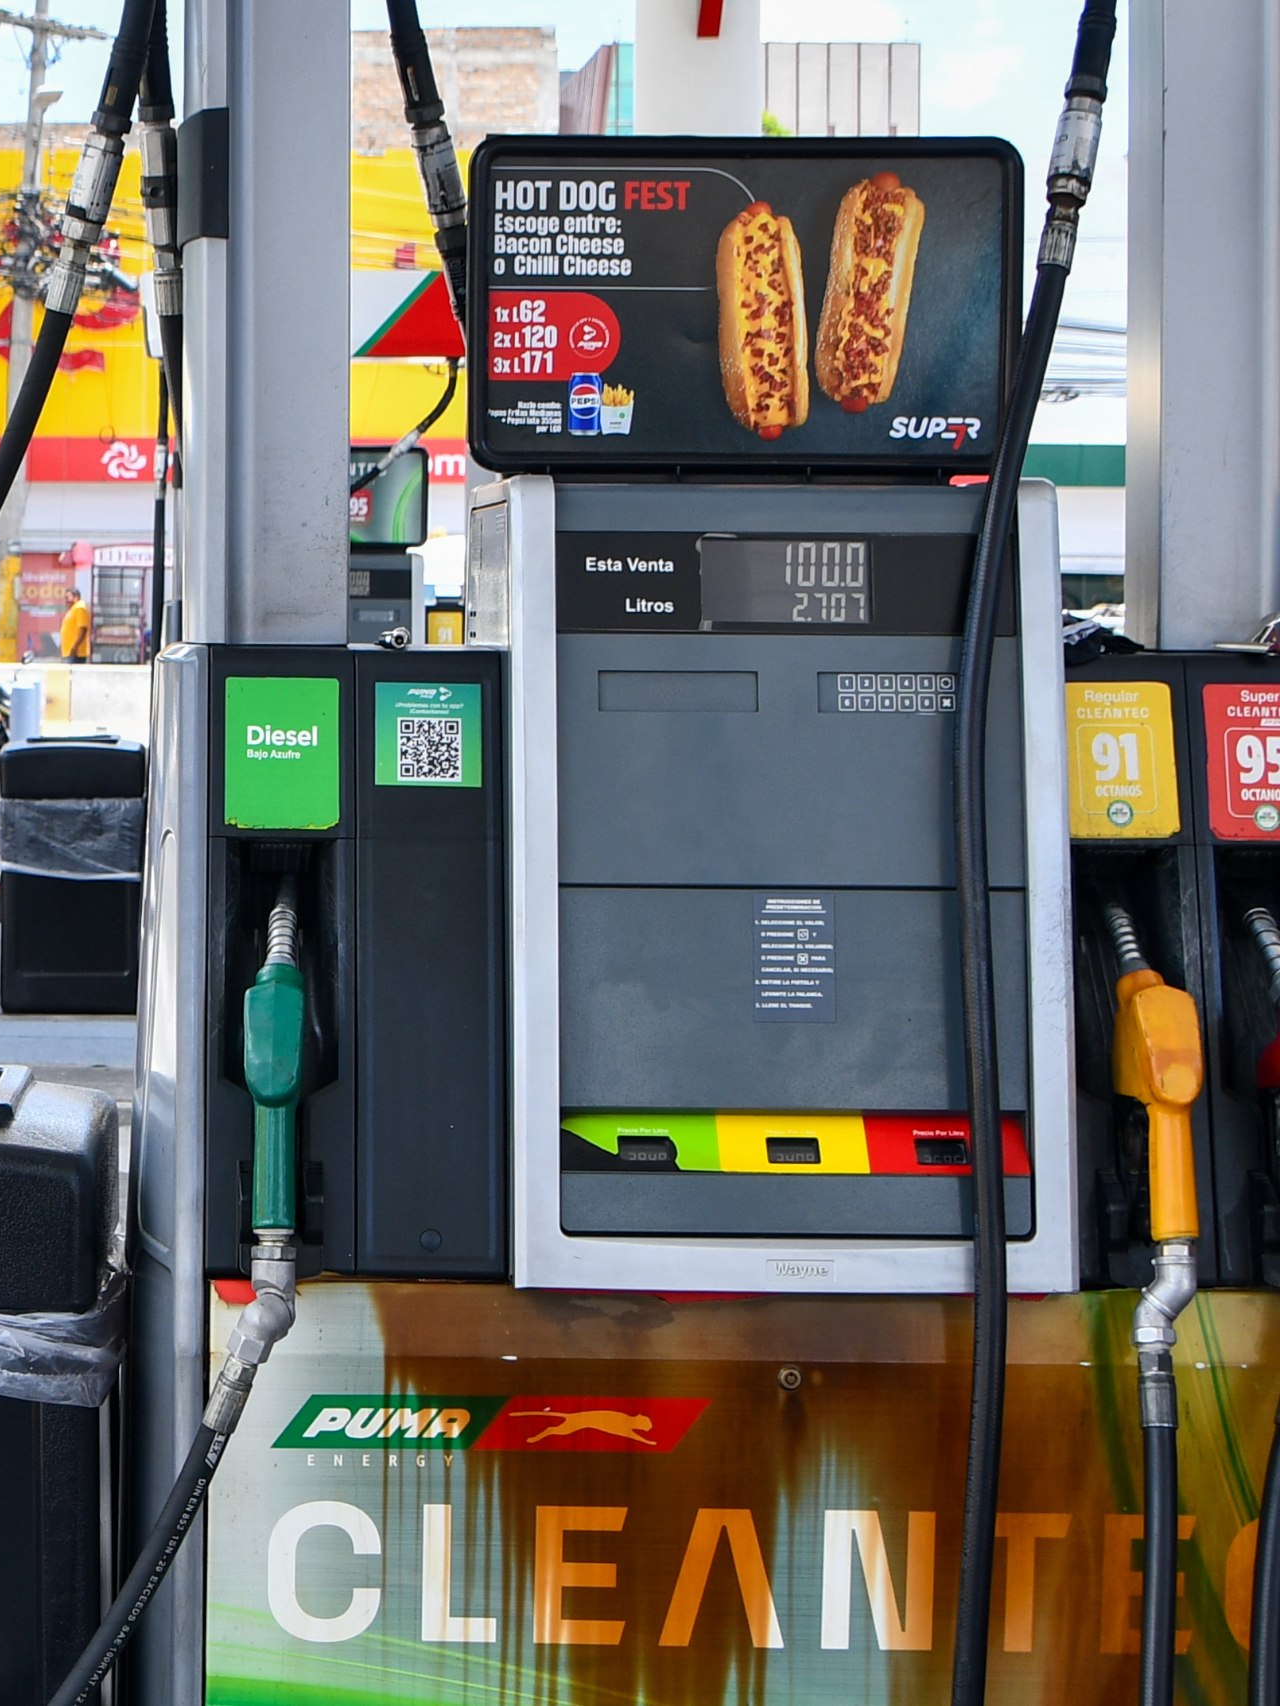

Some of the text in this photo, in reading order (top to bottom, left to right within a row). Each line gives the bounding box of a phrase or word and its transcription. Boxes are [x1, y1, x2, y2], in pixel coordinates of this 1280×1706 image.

[495, 180, 691, 211] HOT DOG FEST
[494, 213, 622, 236] Escoge entre:
[494, 234, 625, 255] Bacon Cheese
[494, 255, 632, 276] o Chilli Cheese
[494, 306, 510, 323] 1x
[494, 332, 512, 348] 2x
[493, 357, 511, 374] 3x
[571, 397, 599, 405] PEPSI
[585, 557, 622, 572] Esta
[626, 557, 675, 572] Venta
[625, 593, 865, 622] Litros 2.707
[1084, 689, 1139, 708] Regular
[1240, 690, 1280, 704] Super
[1077, 707, 1150, 719] CLEANTEC
[1227, 705, 1280, 717] CLEANT
[246, 725, 318, 747] Diesel
[246, 749, 301, 760] Bajo Azufre
[1091, 732, 1140, 782] 91
[1095, 785, 1143, 798] OCTANOS
[775, 1263, 829, 1280] Wayne
[302, 1407, 471, 1440] PUMA
[307, 1454, 454, 1468] ENERGY
[192, 1478, 207, 1497] DIN
[185, 1498, 198, 1512] EN
[267, 1500, 1260, 1655] CLEANTE
[127, 1575, 159, 1622] EXCEEDS
[113, 1624, 131, 1646] SAE
